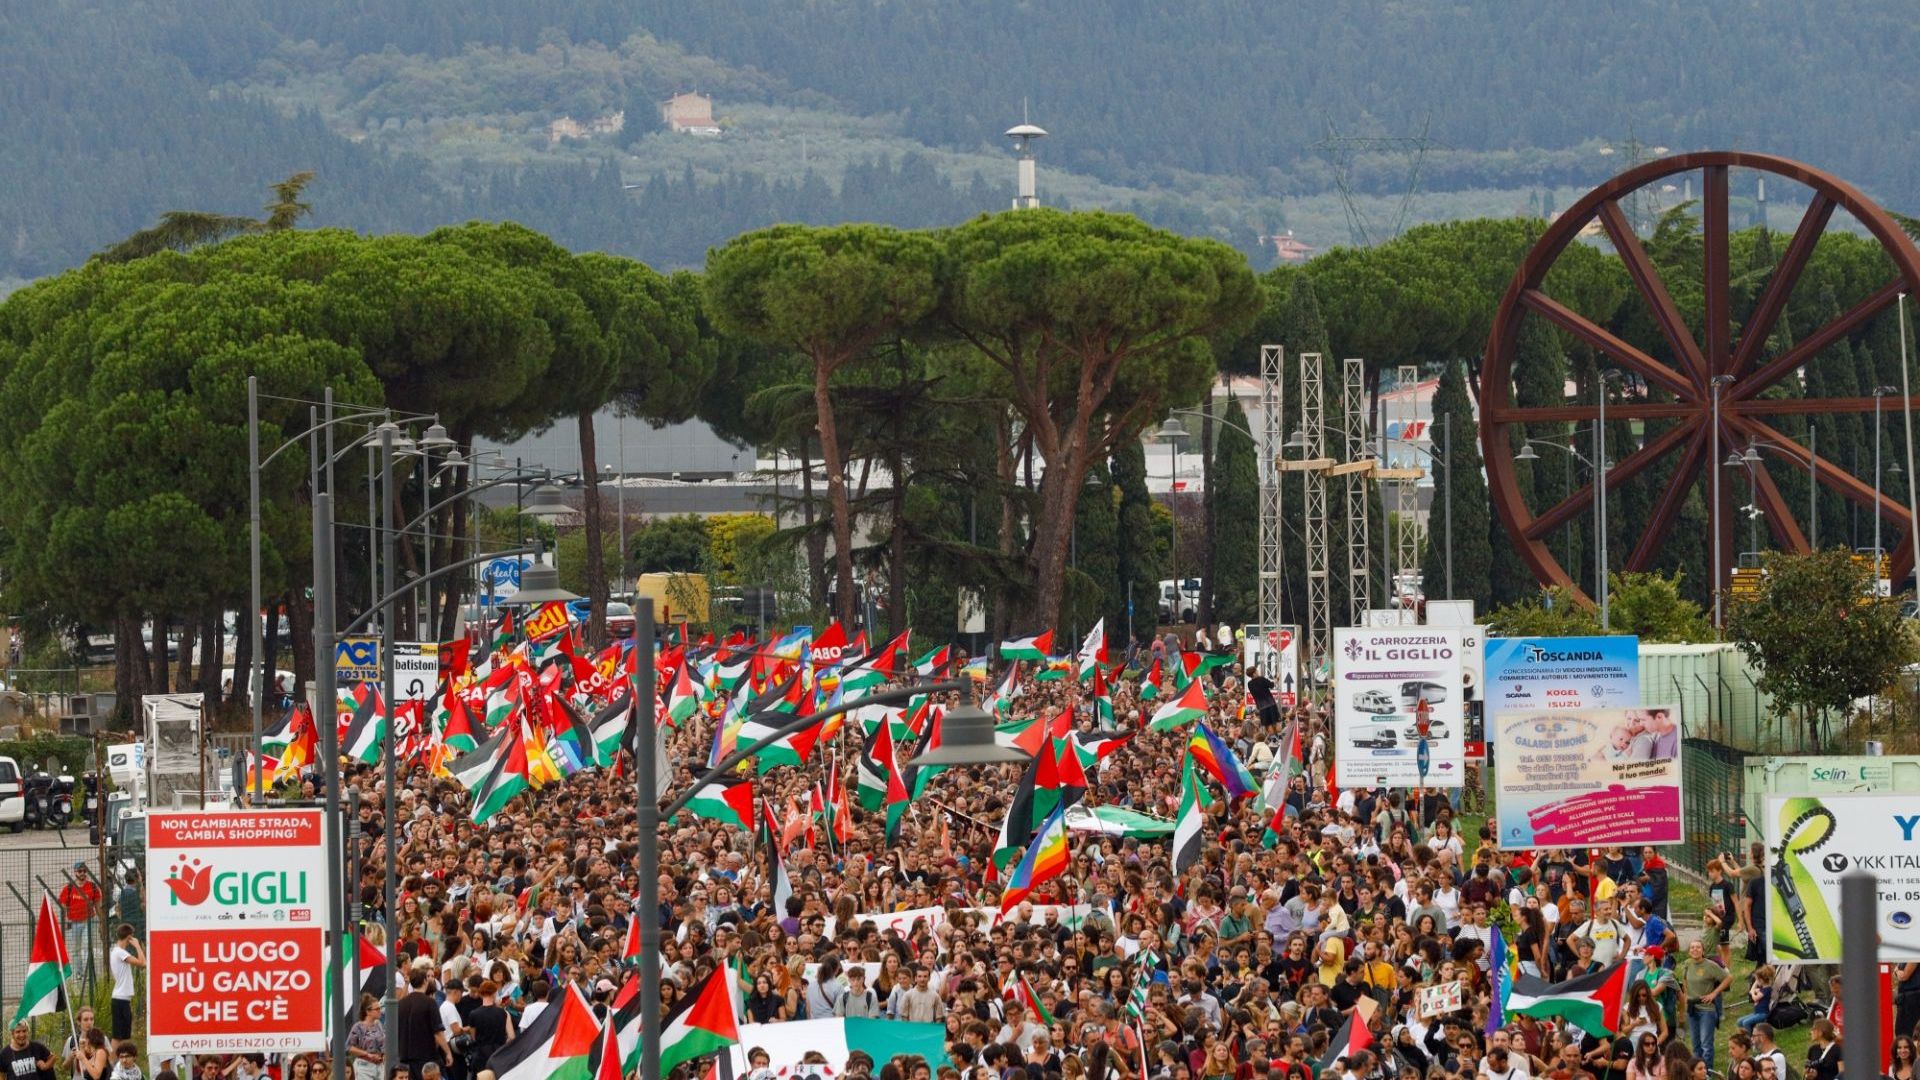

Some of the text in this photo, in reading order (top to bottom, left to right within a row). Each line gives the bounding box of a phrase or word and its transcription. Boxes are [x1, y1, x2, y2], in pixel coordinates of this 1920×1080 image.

[1370, 636, 1447, 646] CARROZZERIA
[336, 641, 377, 666] ACI
[1366, 648, 1453, 660] IL GIGLIO
[395, 660, 437, 670] batistoni
[1535, 723, 1568, 733] G.S.
[1515, 736, 1588, 749] GALARDI SIMONE
[1626, 758, 1672, 770] proteggiamo
[1638, 768, 1666, 776] mondo!
[1811, 767, 1847, 781] Selin
[1559, 801, 1596, 815] PRODUZIONE
[161, 818, 312, 830] NON CAMBIARE STRADA,
[176, 829, 297, 840] CAMBIA SHOPPING!
[1853, 856, 1885, 869] YKK
[213, 871, 306, 905] GIGLI
[1878, 891, 1900, 901] Tel.
[172, 940, 300, 963] IL LUOGO
[162, 967, 311, 993] PIÙ GANZO
[184, 995, 288, 1022] CHE C'È
[172, 1037, 302, 1049] CAMPI BISENZIO (FI)
